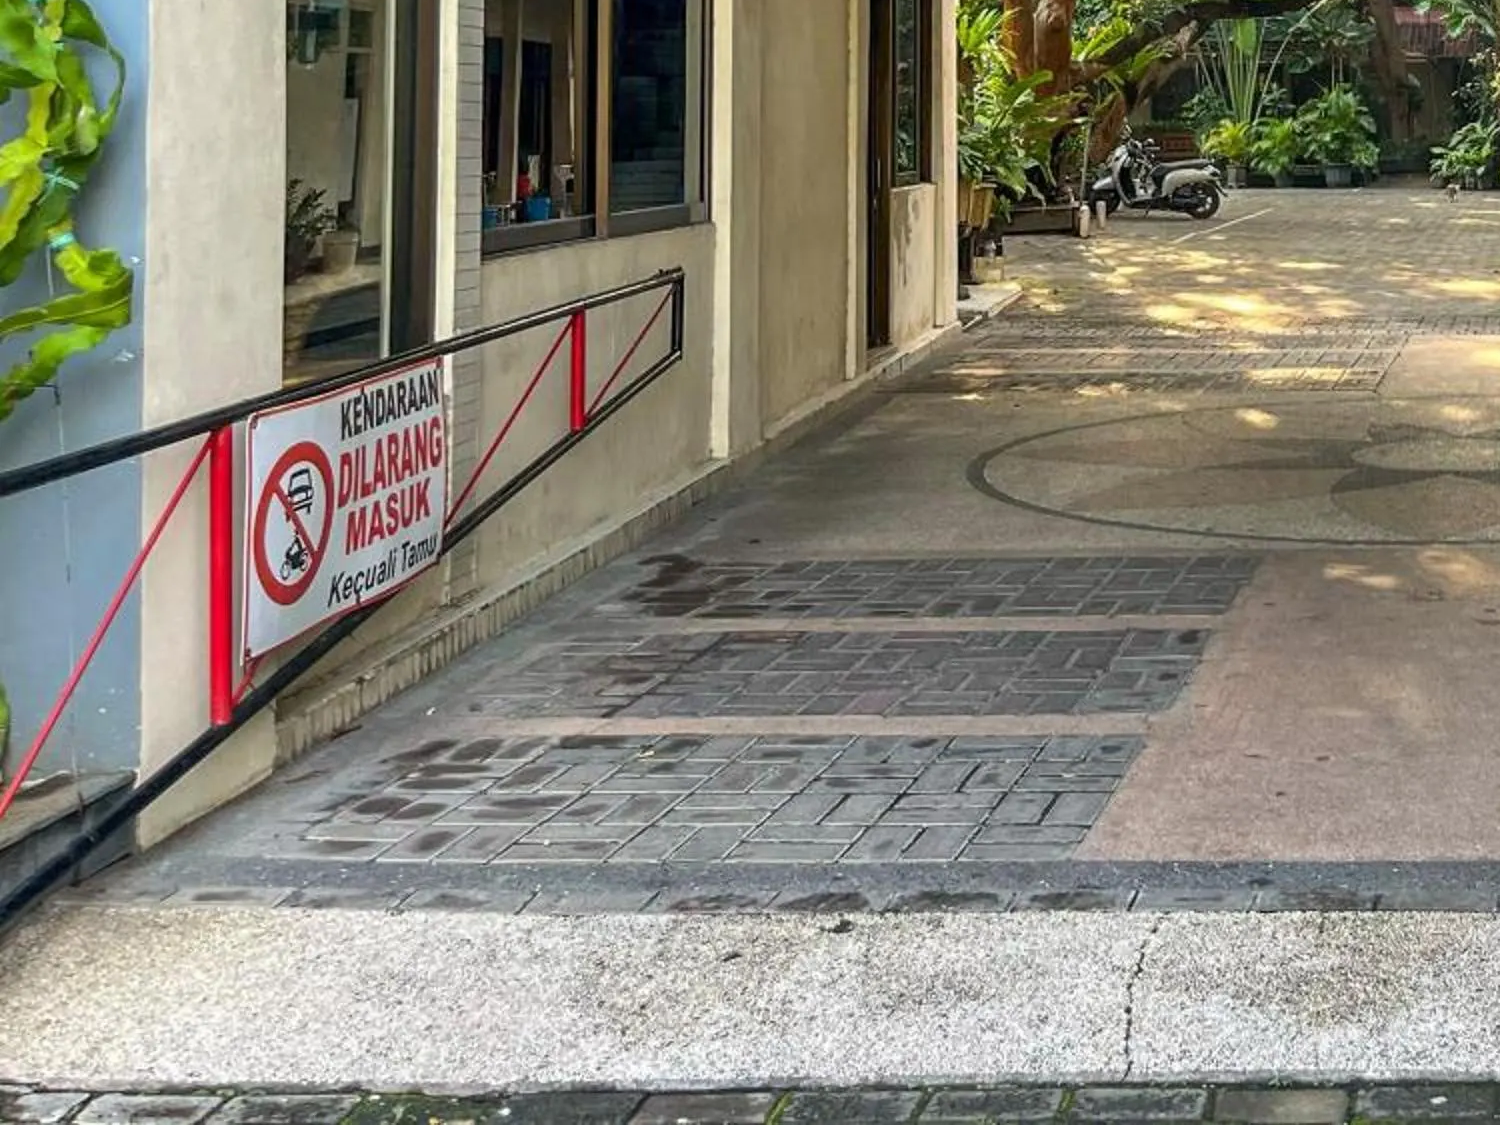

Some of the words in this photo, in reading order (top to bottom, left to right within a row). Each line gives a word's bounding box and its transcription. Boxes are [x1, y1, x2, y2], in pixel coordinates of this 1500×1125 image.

[341, 370, 439, 440] KENDARAAN
[338, 416, 442, 508] DILARANG
[345, 477, 431, 555] MASUK
[327, 549, 398, 608] Kecuali
[401, 531, 438, 572] Tamu
